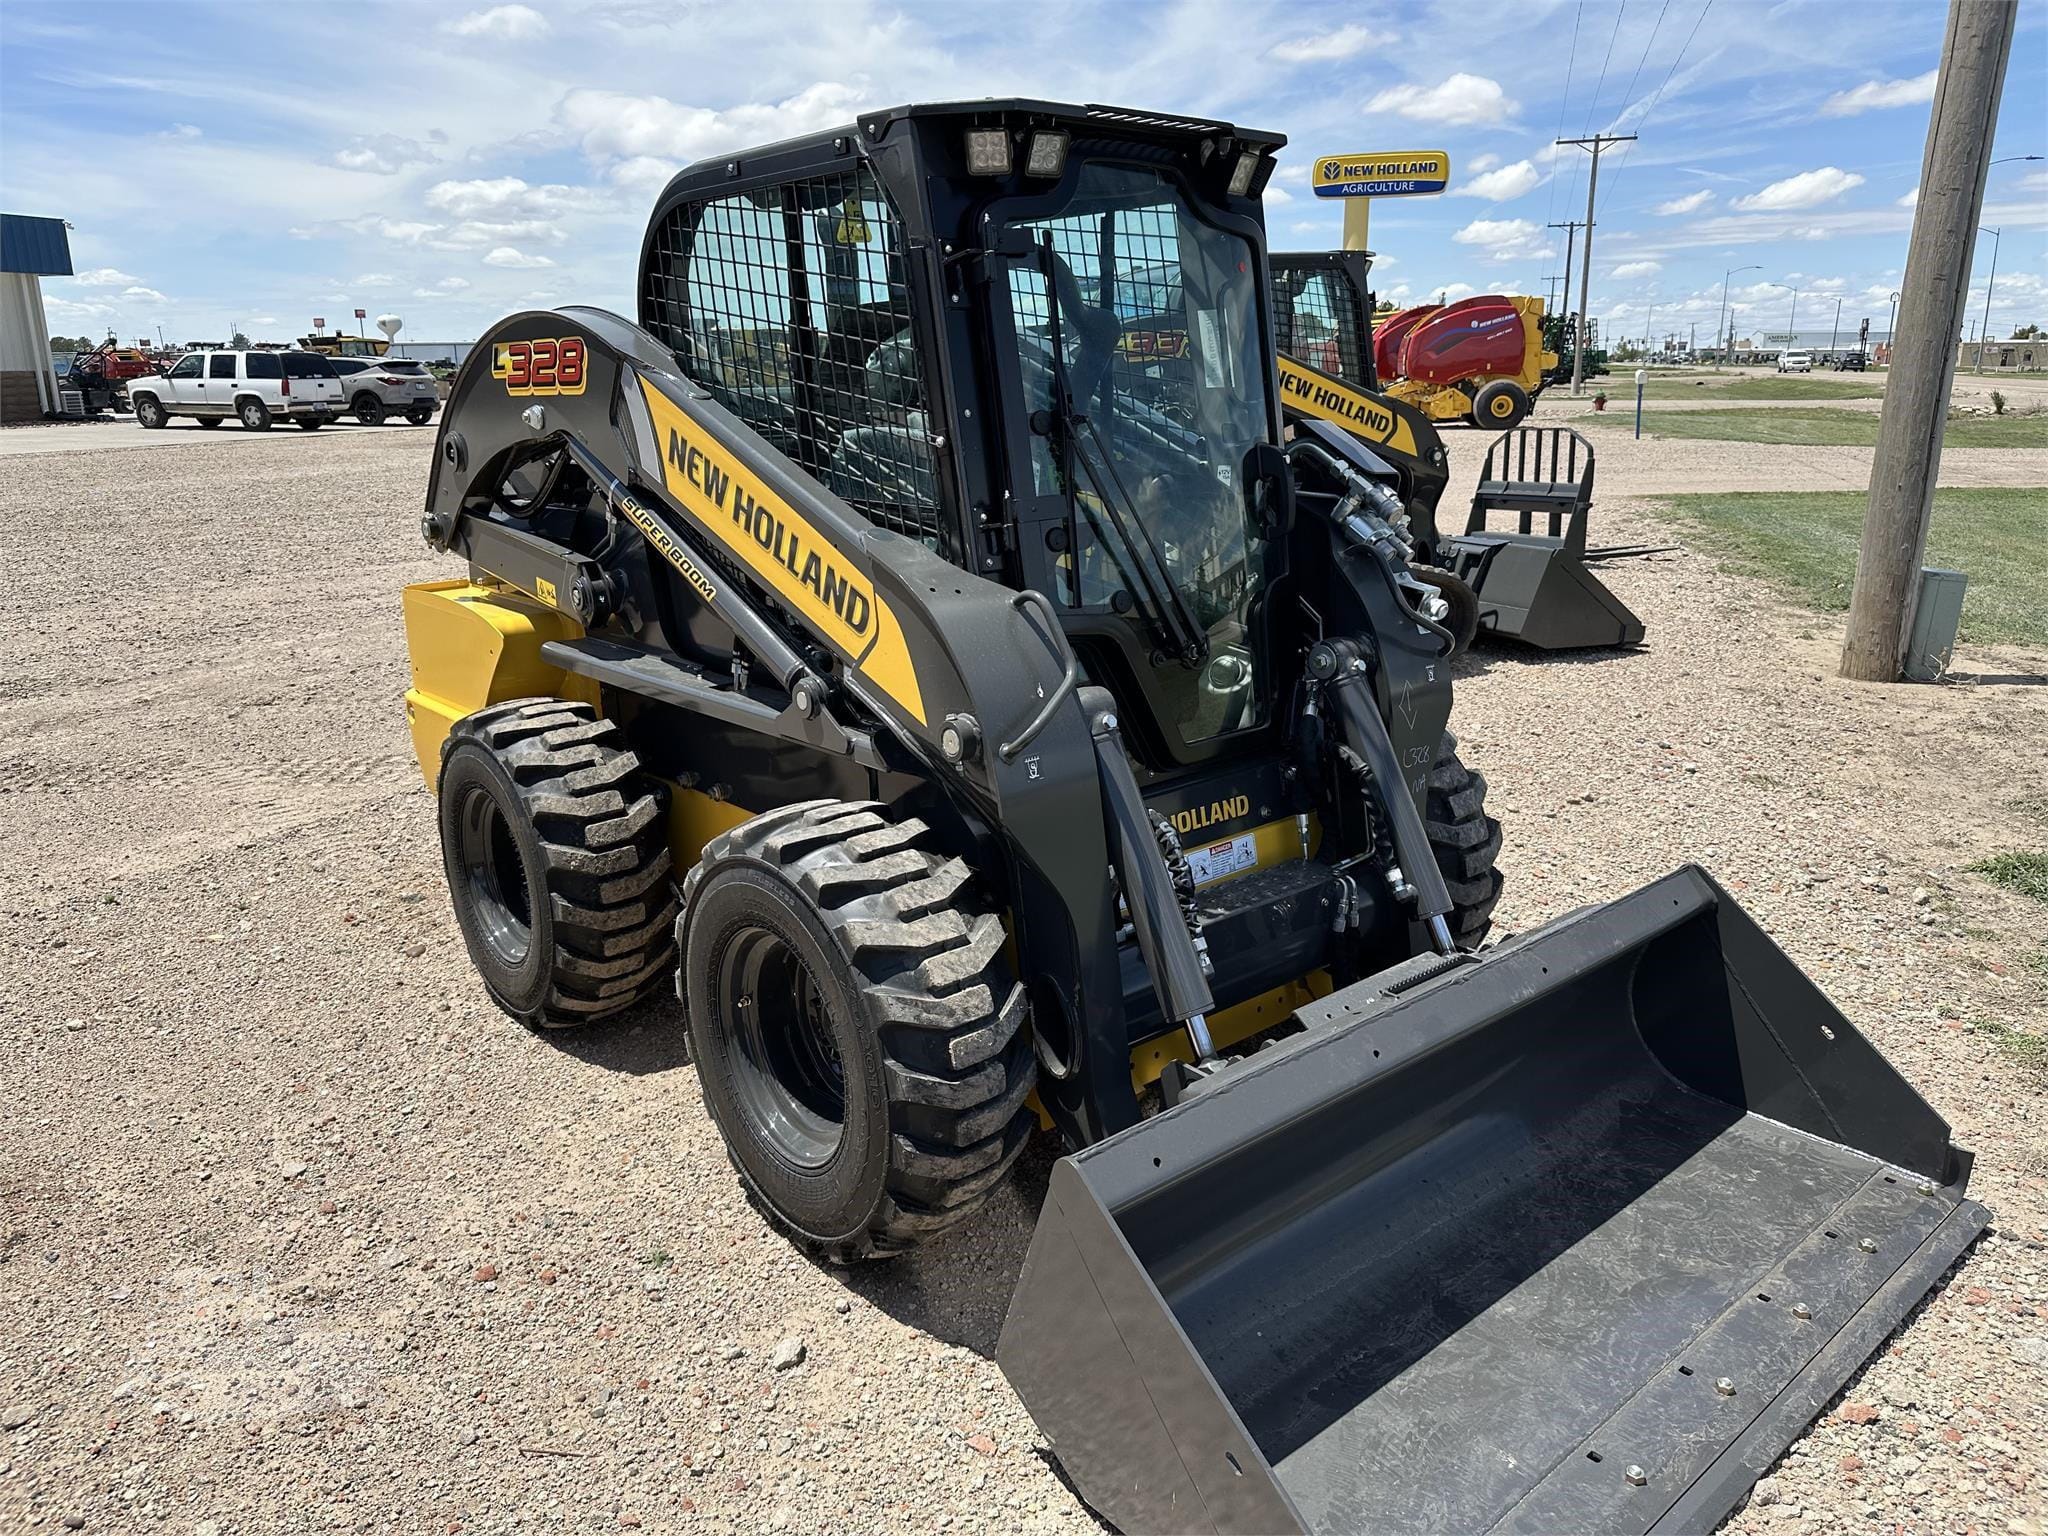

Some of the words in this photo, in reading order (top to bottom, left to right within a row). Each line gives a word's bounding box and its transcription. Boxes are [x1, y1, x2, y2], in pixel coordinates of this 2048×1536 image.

[1341, 181, 1415, 193] AGRICULTURE
[1343, 163, 1374, 177] NEW
[1376, 161, 1439, 175] HOLLAND
[492, 337, 588, 396] L328
[1312, 386, 1391, 433] HOLLAND
[622, 497, 672, 554] SUPER
[668, 547, 716, 601] BOOM
[667, 427, 730, 509] NEW
[732, 483, 871, 635] HOLLAND
